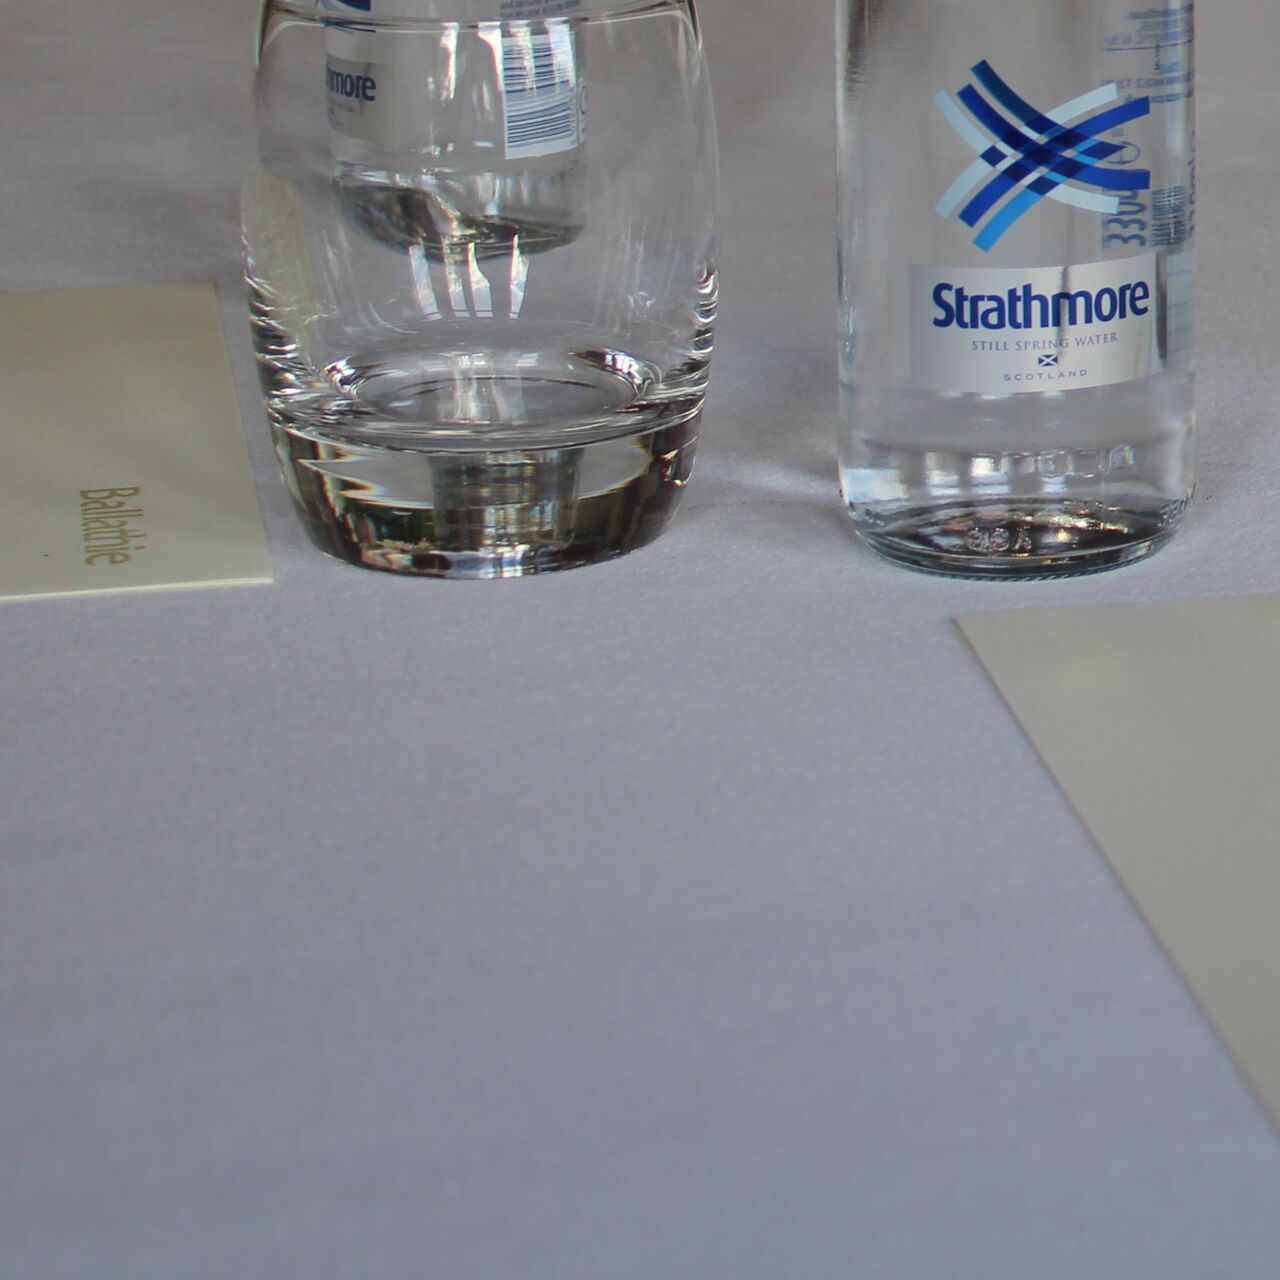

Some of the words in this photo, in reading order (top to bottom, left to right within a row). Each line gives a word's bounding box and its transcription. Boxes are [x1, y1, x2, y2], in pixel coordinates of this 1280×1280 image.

[932, 280, 1150, 331] Strathmore
[972, 340, 1010, 352] STILL
[1016, 337, 1070, 351] SPRING
[1075, 332, 1119, 347] WATER
[1003, 369, 1088, 382] SCOTLAND
[80, 486, 146, 566] Ballathie
